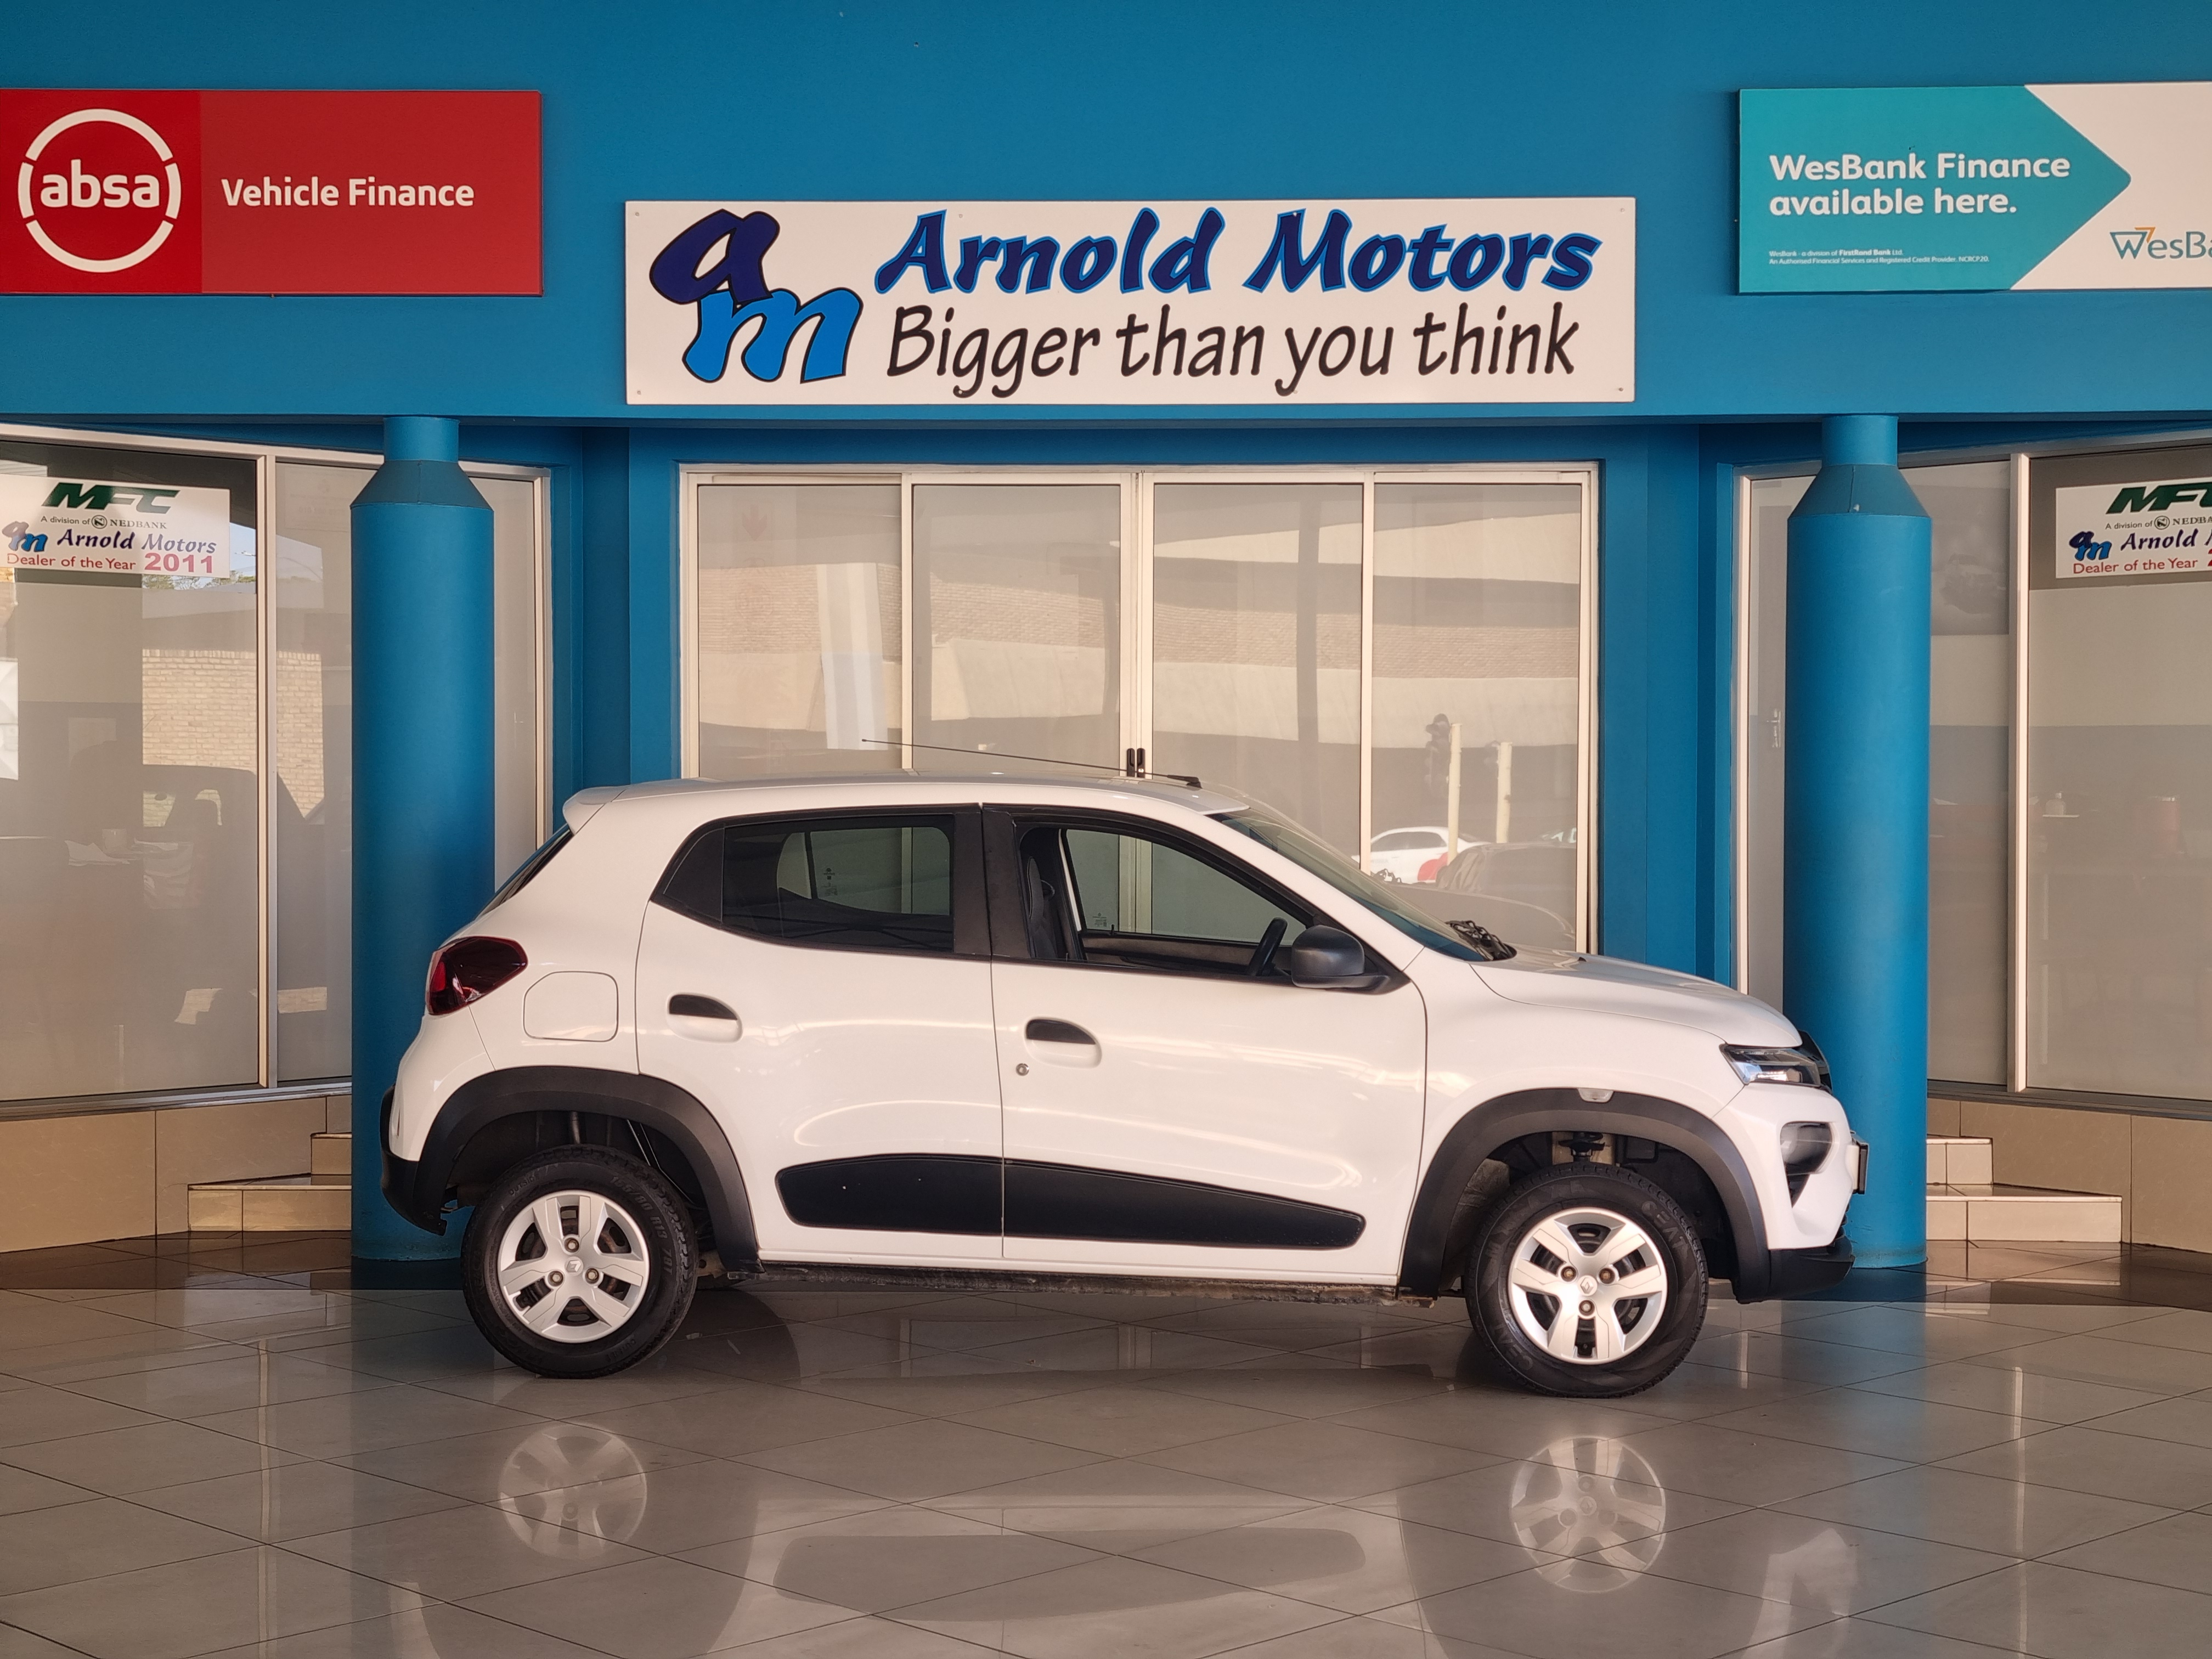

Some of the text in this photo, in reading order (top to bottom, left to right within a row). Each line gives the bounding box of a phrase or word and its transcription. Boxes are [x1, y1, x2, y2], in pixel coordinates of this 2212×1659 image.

[1769, 153, 2071, 180] WesBank Finance
[41, 159, 160, 208] absa
[221, 177, 475, 207] Vehicle Finance
[1769, 188, 2017, 216] available here.
[874, 207, 1603, 294] Arnold Motors
[2109, 226, 2212, 259] WesB
[887, 302, 1579, 398] Bigger than you think
[41, 482, 181, 514] MFC
[50, 516, 80, 525] division
[109, 519, 167, 529] NEDBANK
[2114, 521, 2143, 529] division
[57, 528, 217, 554] Arnold Motors
[2120, 528, 2199, 551] Arnold
[7, 552, 213, 574] Dealer of the Year 2011
[2073, 562, 2119, 574] Dealer
[2124, 560, 2139, 572] of
[2143, 558, 2165, 571] the
[2168, 557, 2198, 569] Year
[1641, 1201, 1688, 1252] CEAT
